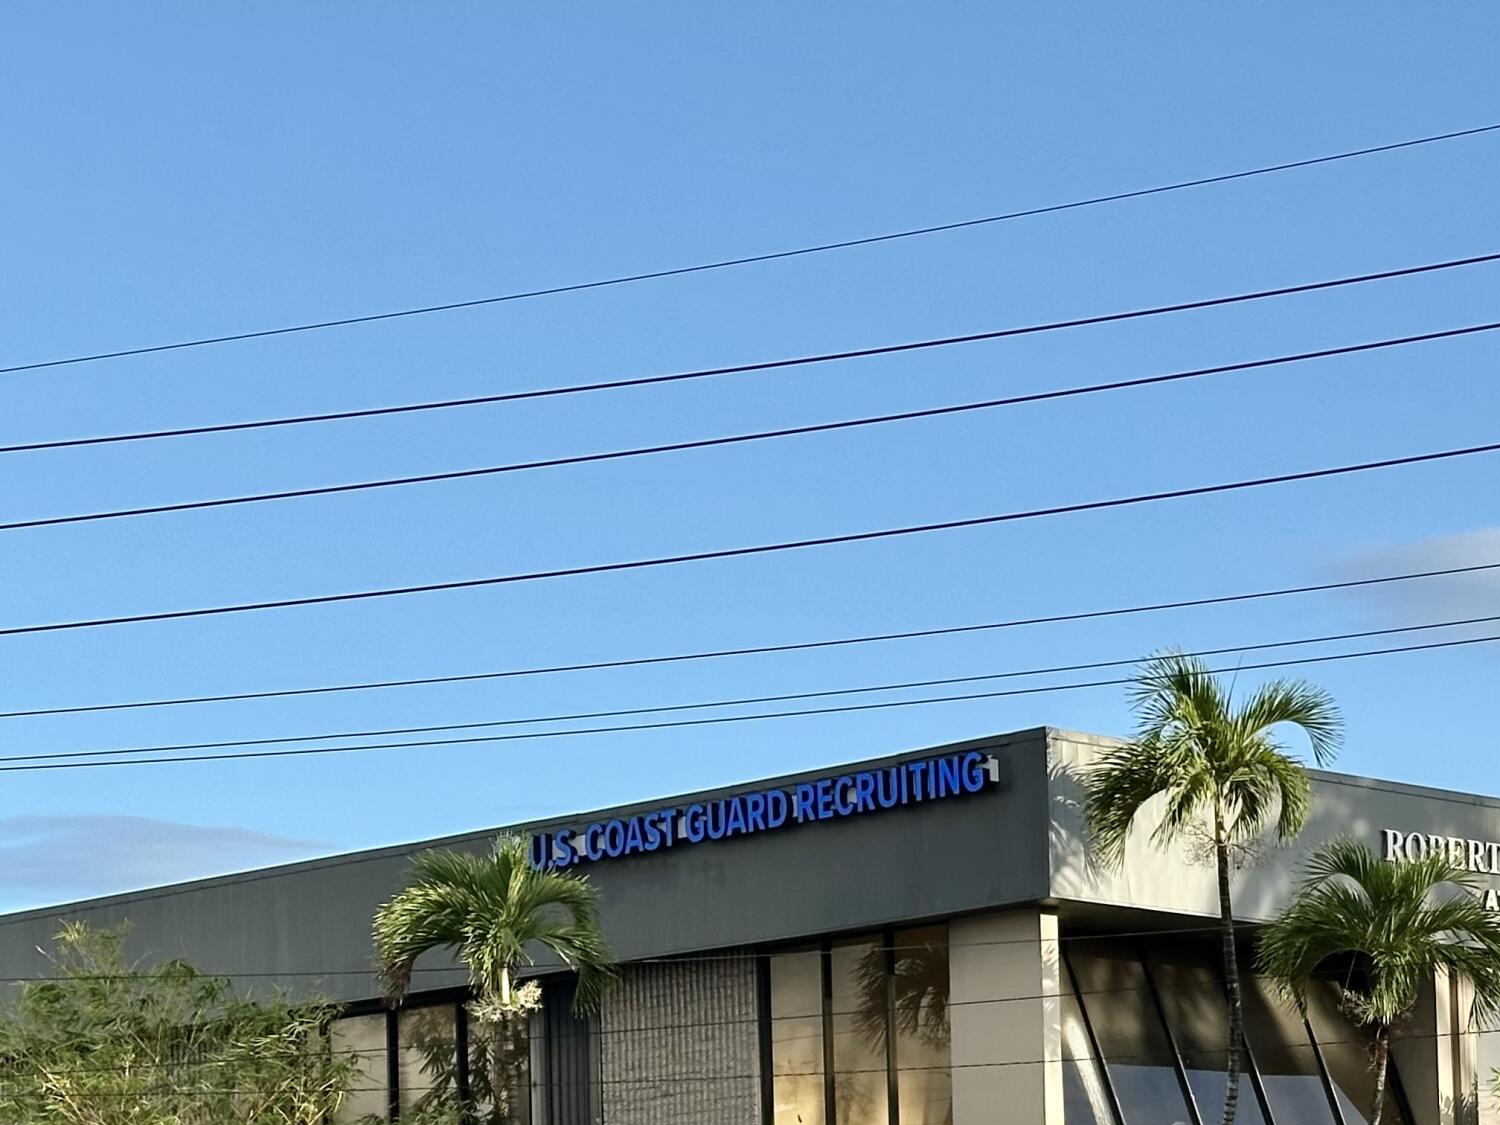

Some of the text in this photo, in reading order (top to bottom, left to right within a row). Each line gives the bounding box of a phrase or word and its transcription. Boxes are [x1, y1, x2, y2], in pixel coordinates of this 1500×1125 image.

[528, 751, 985, 871] U.S. COAST GUARD RECRUITING
